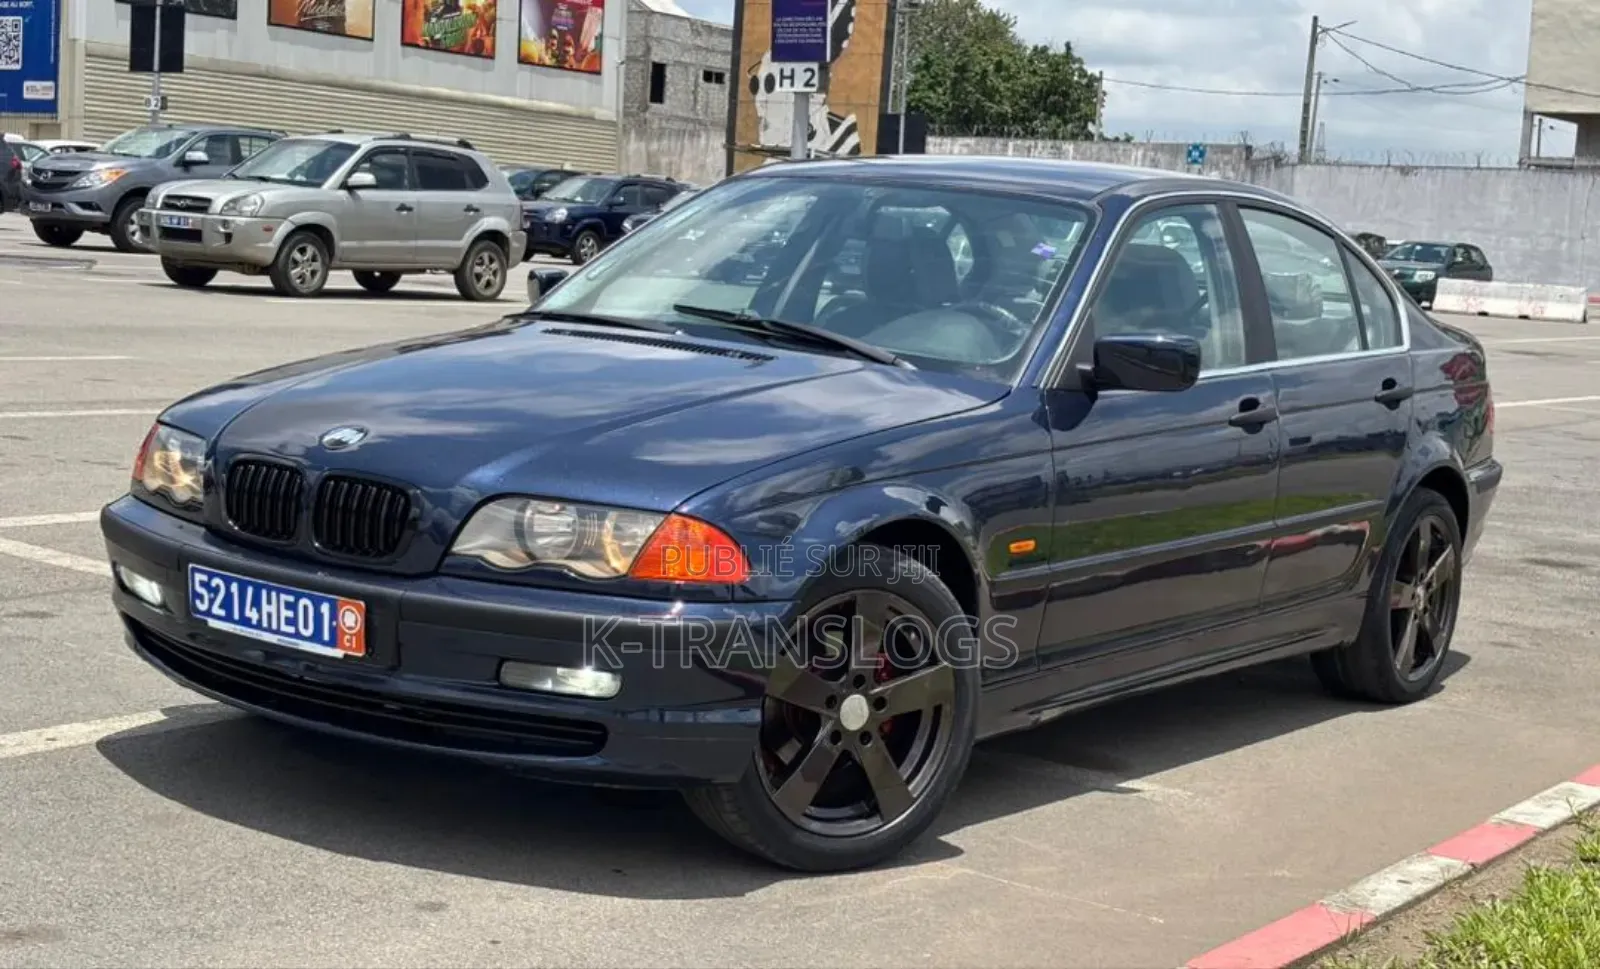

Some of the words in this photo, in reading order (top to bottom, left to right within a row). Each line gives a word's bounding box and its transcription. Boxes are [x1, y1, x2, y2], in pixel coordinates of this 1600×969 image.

[779, 67, 795, 88] H
[803, 67, 817, 88] 2
[193, 572, 331, 642] 5214HE01
[343, 635, 357, 649] CI
